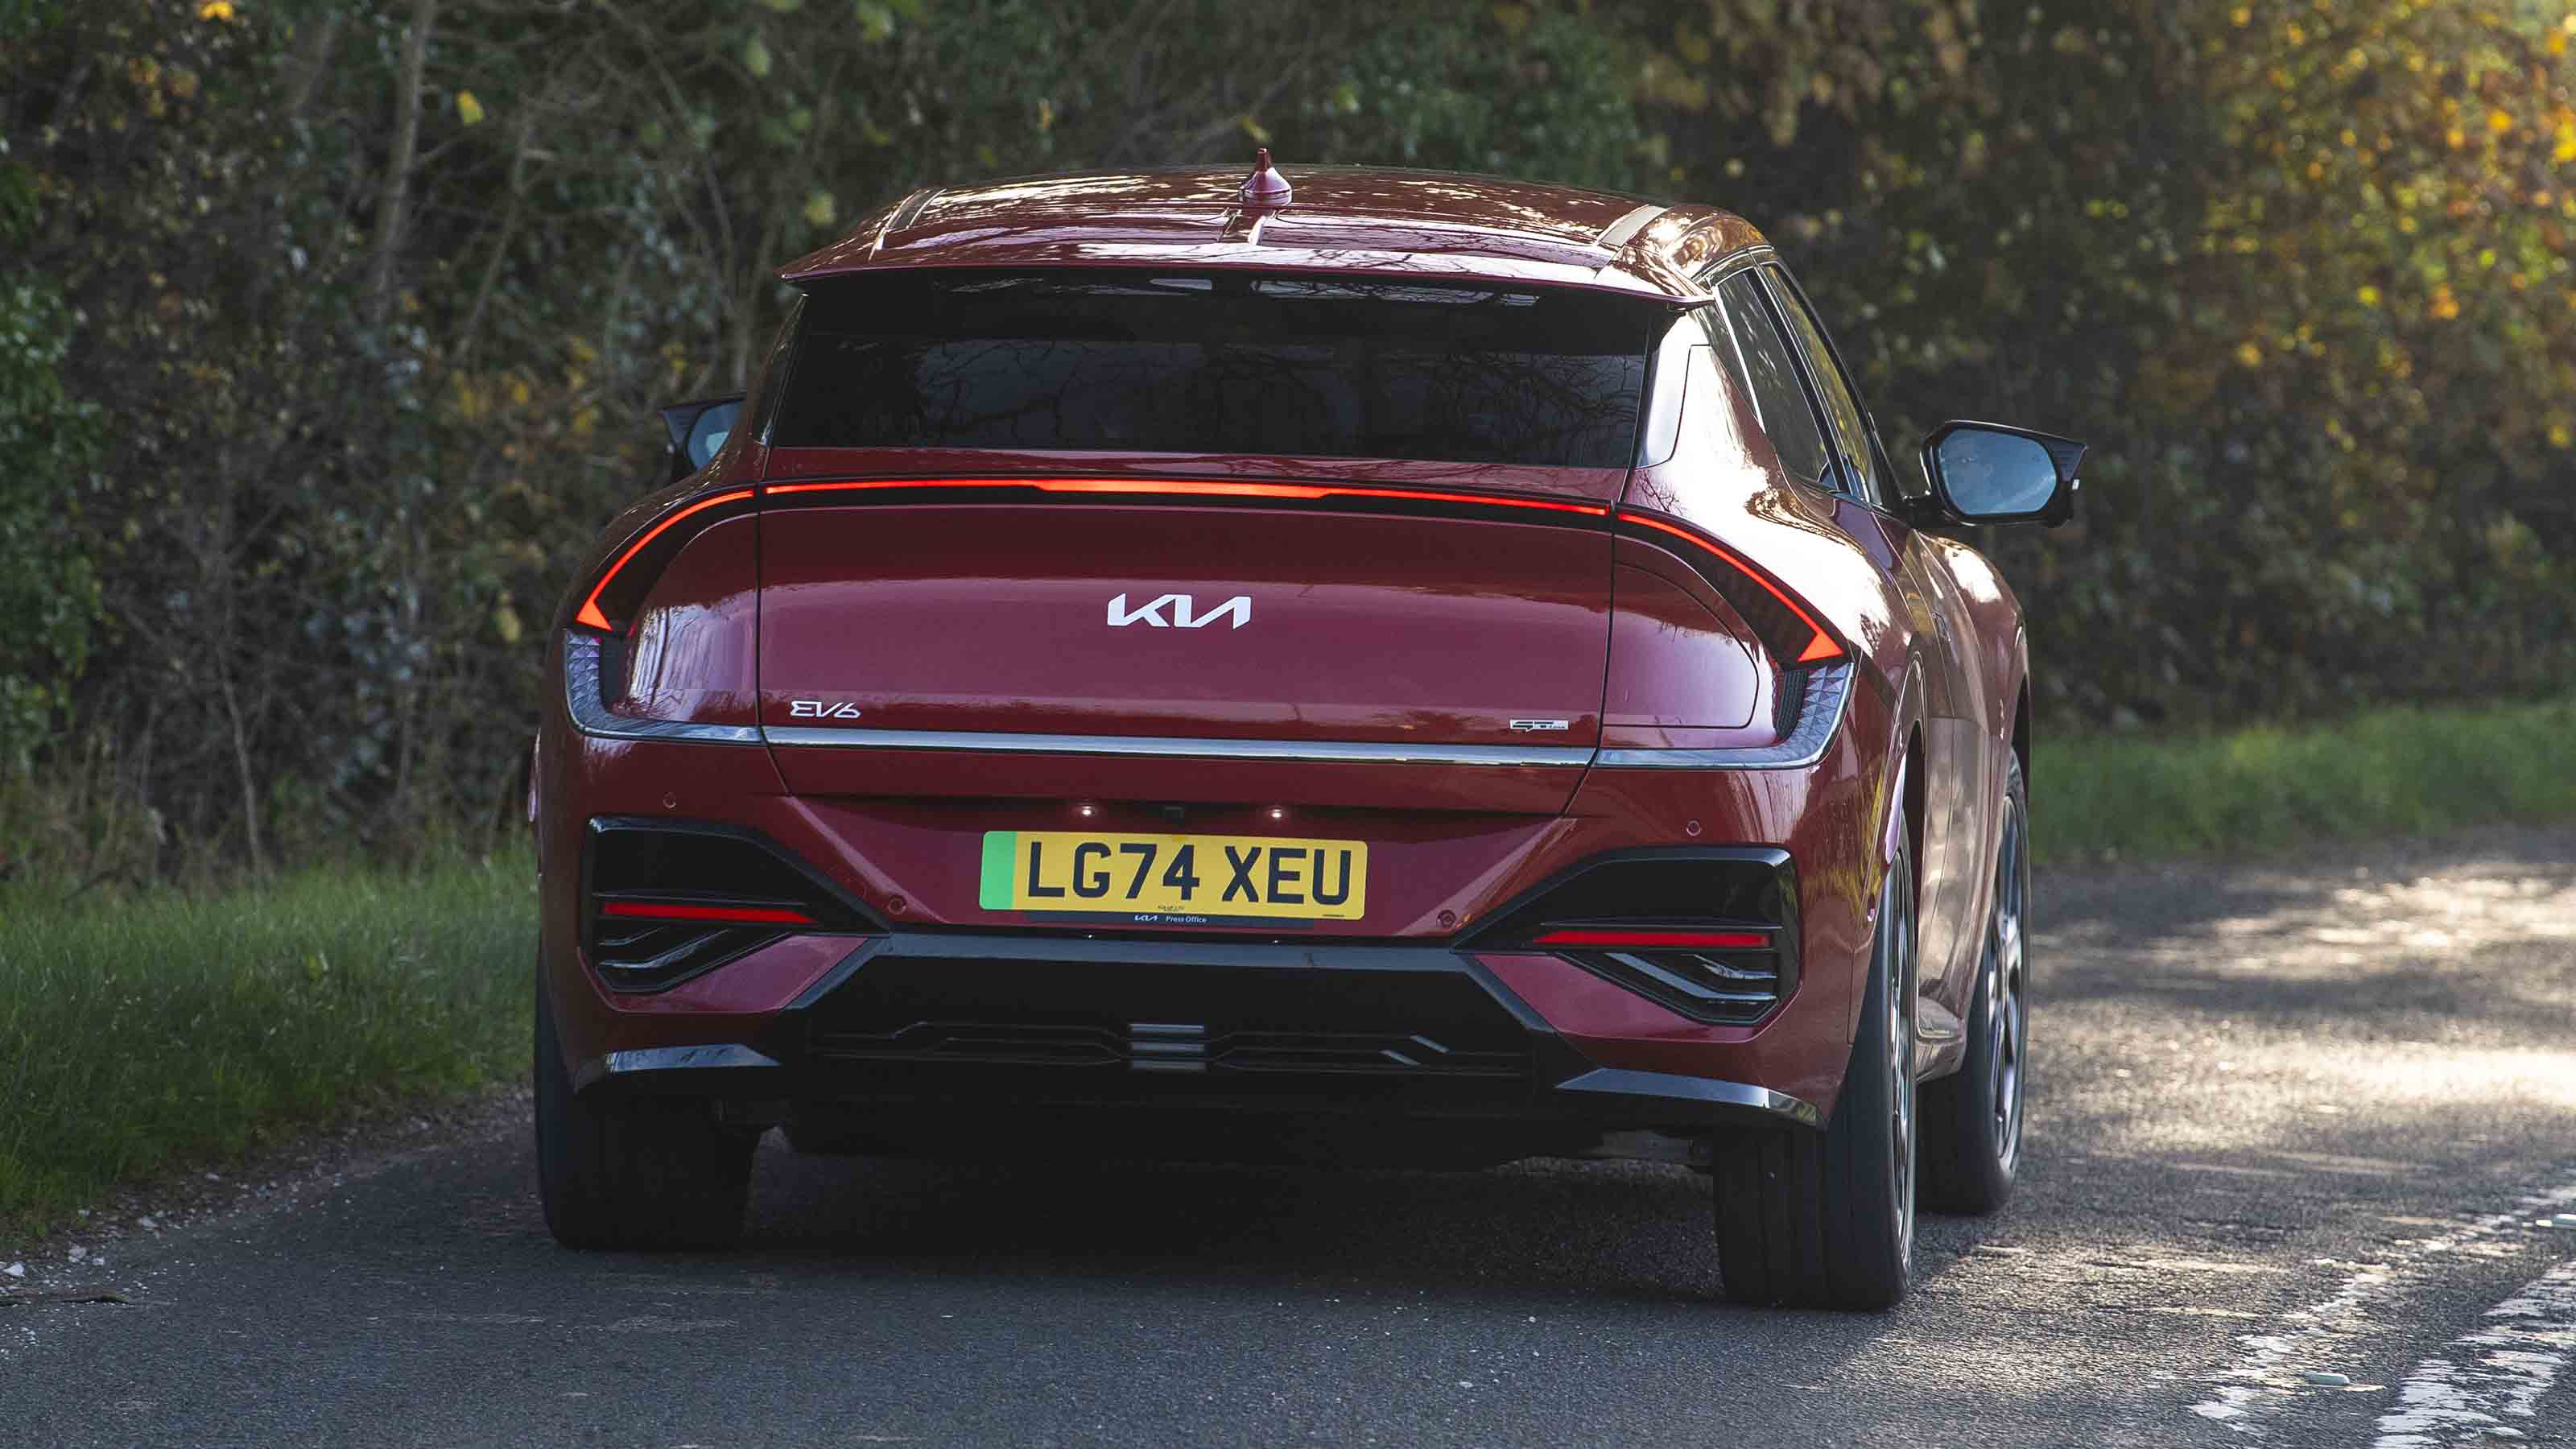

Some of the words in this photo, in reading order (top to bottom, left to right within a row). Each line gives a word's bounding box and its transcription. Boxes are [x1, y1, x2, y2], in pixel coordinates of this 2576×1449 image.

[791, 700, 861, 718] EV6
[1027, 841, 1200, 902] LG74
[1222, 845, 1352, 906] XEU
[1166, 914, 1184, 923] Press
[1185, 915, 1207, 923] Office
